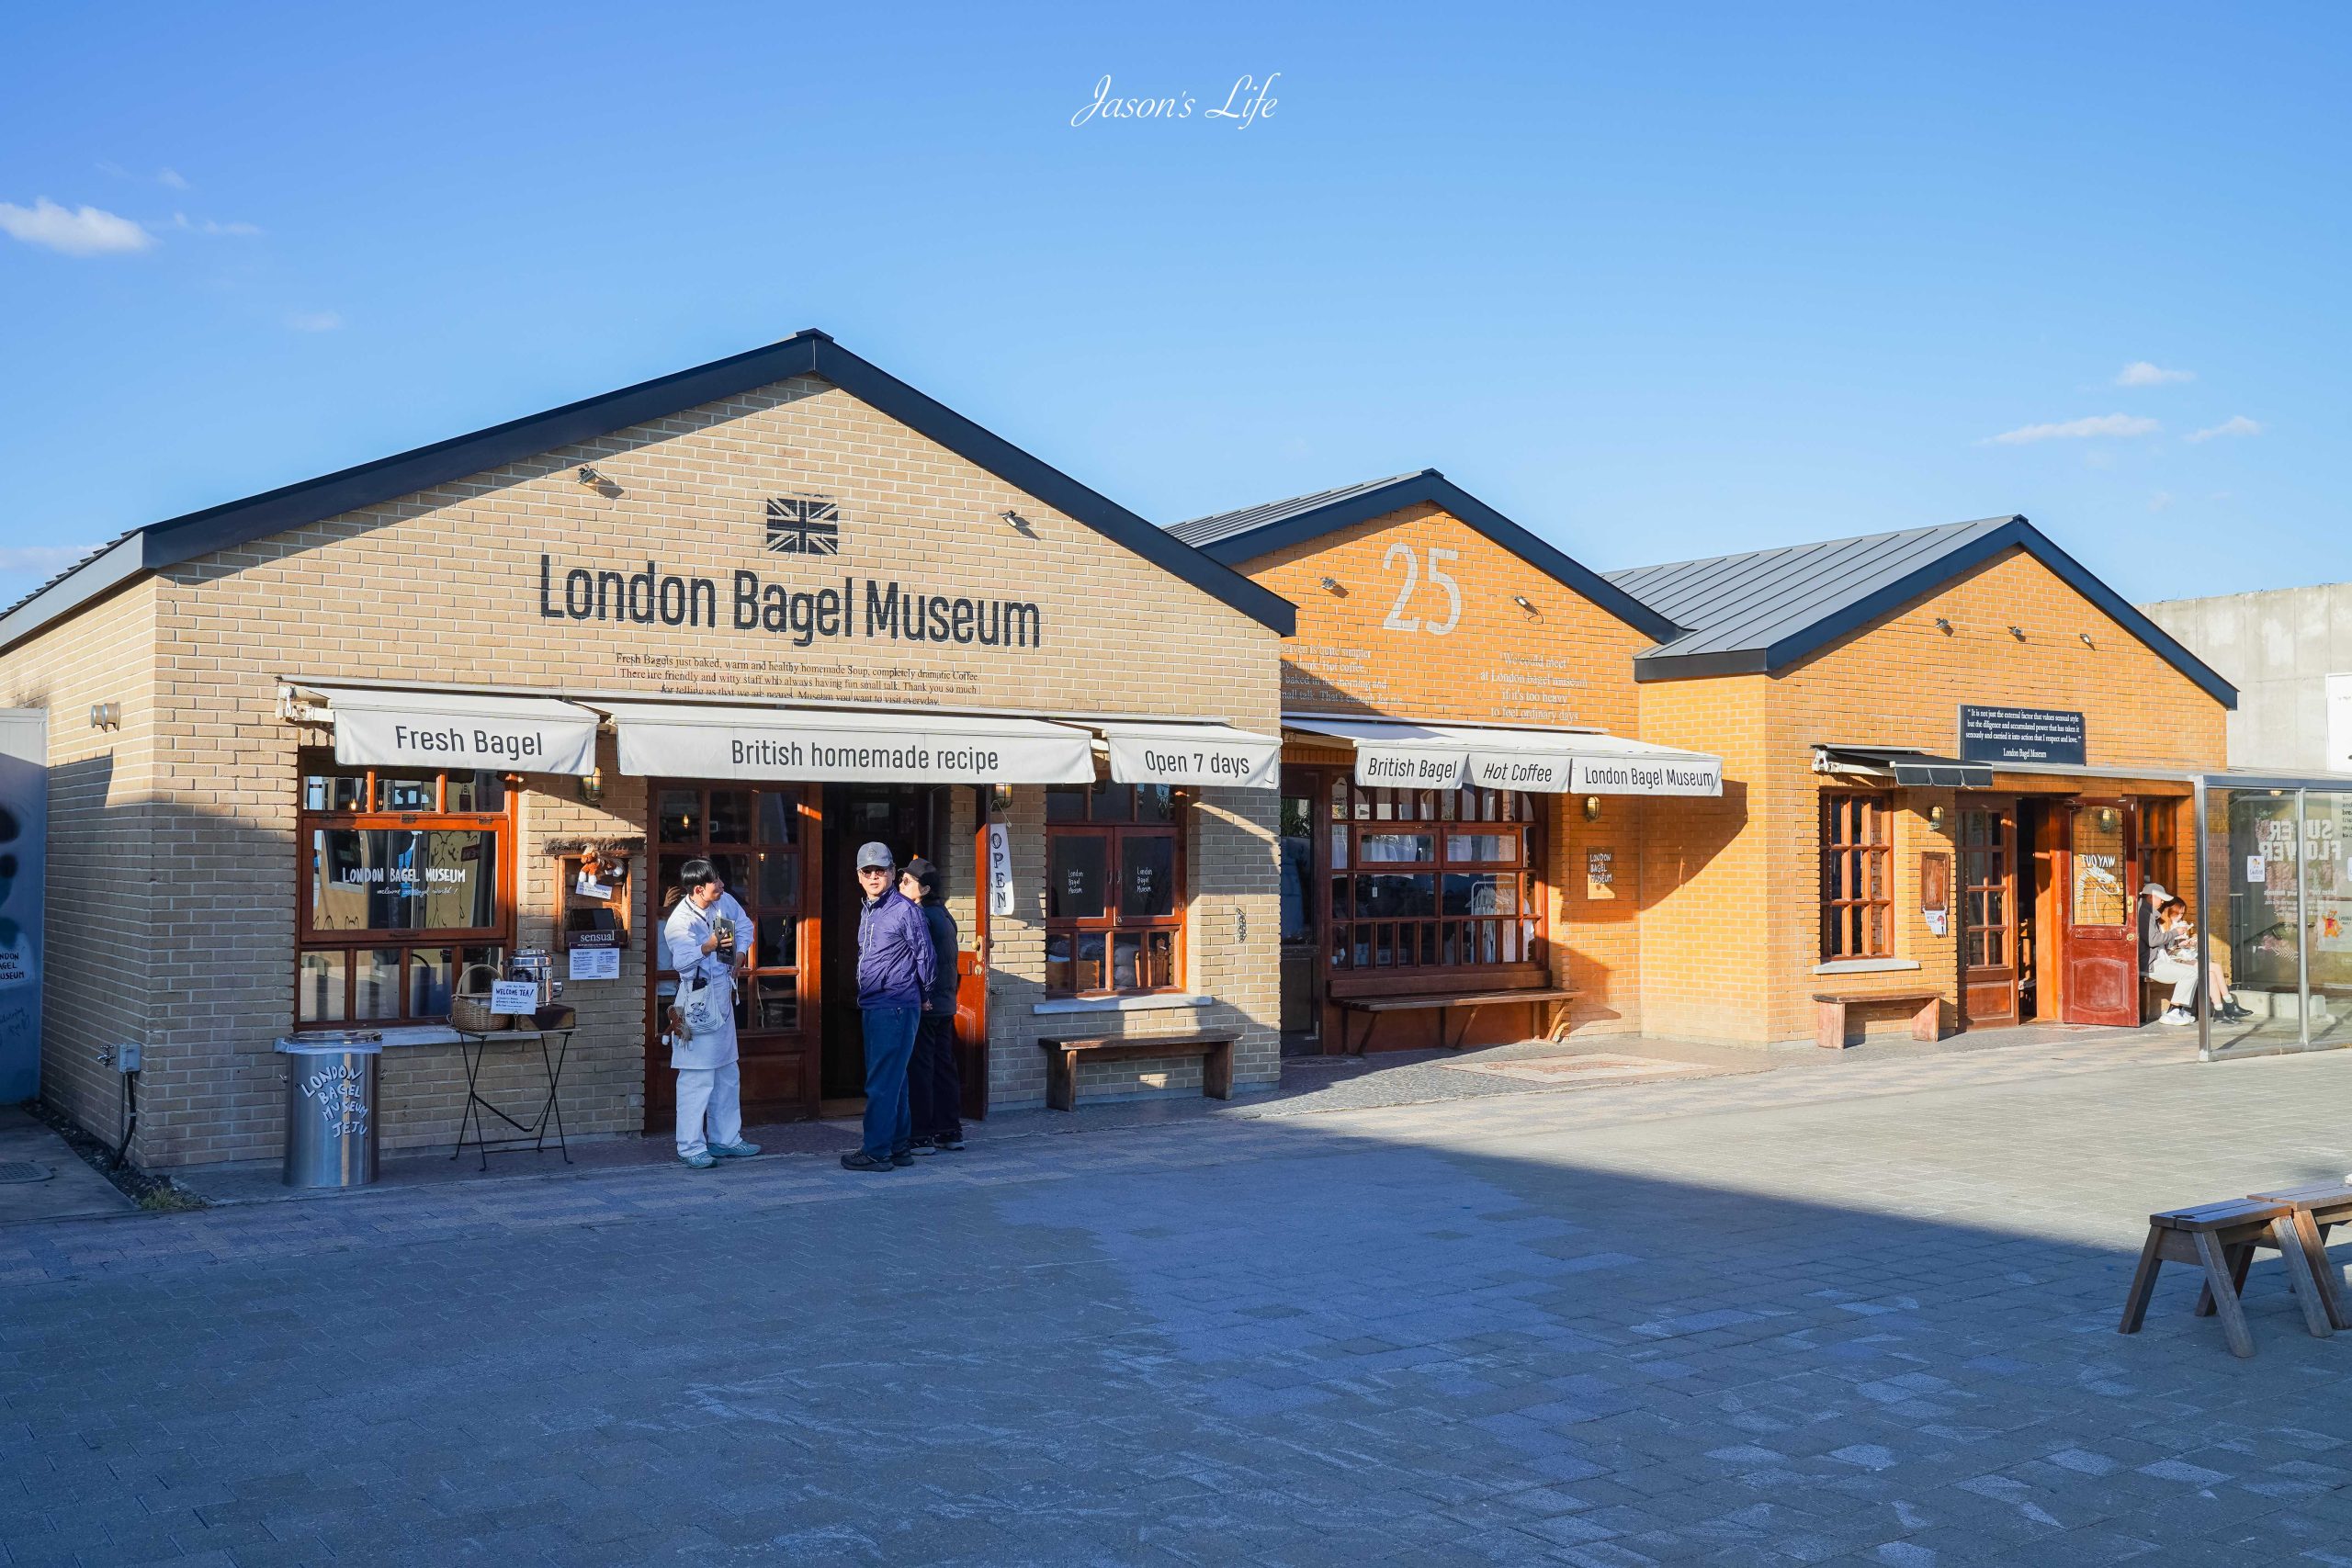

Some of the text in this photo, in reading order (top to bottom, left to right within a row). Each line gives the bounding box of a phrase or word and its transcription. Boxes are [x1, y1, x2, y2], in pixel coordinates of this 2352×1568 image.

[1382, 543, 1462, 636] 25
[541, 555, 1040, 649] London Bagel Museum
[1309, 645, 1317, 655] is
[1319, 646, 1340, 658] quite
[1503, 651, 1567, 669] We could meet
[616, 653, 980, 682] Fresh Bagels just baked, warm and healthy homemade Soup, completely dramatic Coffee.
[1323, 660, 1337, 671] Hot
[620, 668, 645, 679] There
[664, 670, 698, 682] friendly
[701, 671, 716, 682] and
[719, 671, 741, 684] witty
[743, 673, 763, 684] staff
[764, 675, 782, 685] who
[784, 676, 812, 688] always
[815, 677, 842, 690] having
[845, 679, 858, 688] fun
[860, 680, 881, 690] small
[902, 681, 926, 692] Thank
[929, 683, 944, 694] you
[956, 684, 977, 694] much
[1285, 674, 1310, 684] baked
[1312, 676, 1320, 685] in
[1322, 676, 1335, 686] the
[1337, 678, 1370, 691] morning
[1480, 670, 1588, 687] at London bagel museum
[718, 687, 734, 696] that
[835, 694, 850, 702] you
[853, 693, 872, 702] want
[874, 694, 882, 703] to
[885, 694, 901, 704] visit
[1501, 688, 1567, 705] if it's too heavy
[1491, 705, 1578, 723] to feel ordinary days
[2036, 725, 2048, 733] power
[395, 725, 543, 761] Fresh Bagel
[731, 739, 999, 775] British homemade recipe
[2003, 748, 2047, 760] London Bagel Museum
[1145, 750, 1250, 776] Open 7 days
[1368, 757, 1457, 782] British Bagel
[1483, 763, 1553, 783] Hot Coffee
[1585, 766, 1713, 788] London Bagel Museum
[1589, 853, 1611, 863] LONDON
[342, 867, 466, 884] LONDON BAGEL MUSEUM
[991, 832, 1006, 908] OPEN
[1068, 868, 1084, 878] London
[1136, 866, 1152, 875] London
[1590, 863, 1608, 874] BAGEL
[1069, 878, 1080, 887] Bagel
[1136, 876, 1149, 886] Bagel
[1590, 874, 1612, 883] MUSEUM
[580, 930, 615, 942] sensual
[520, 988, 534, 998] TEA!
[300, 1065, 363, 1098] LONDON
[317, 1084, 361, 1106] BAGEL
[322, 1100, 368, 1122] MUSEUM
[332, 1121, 368, 1138] JEJU
